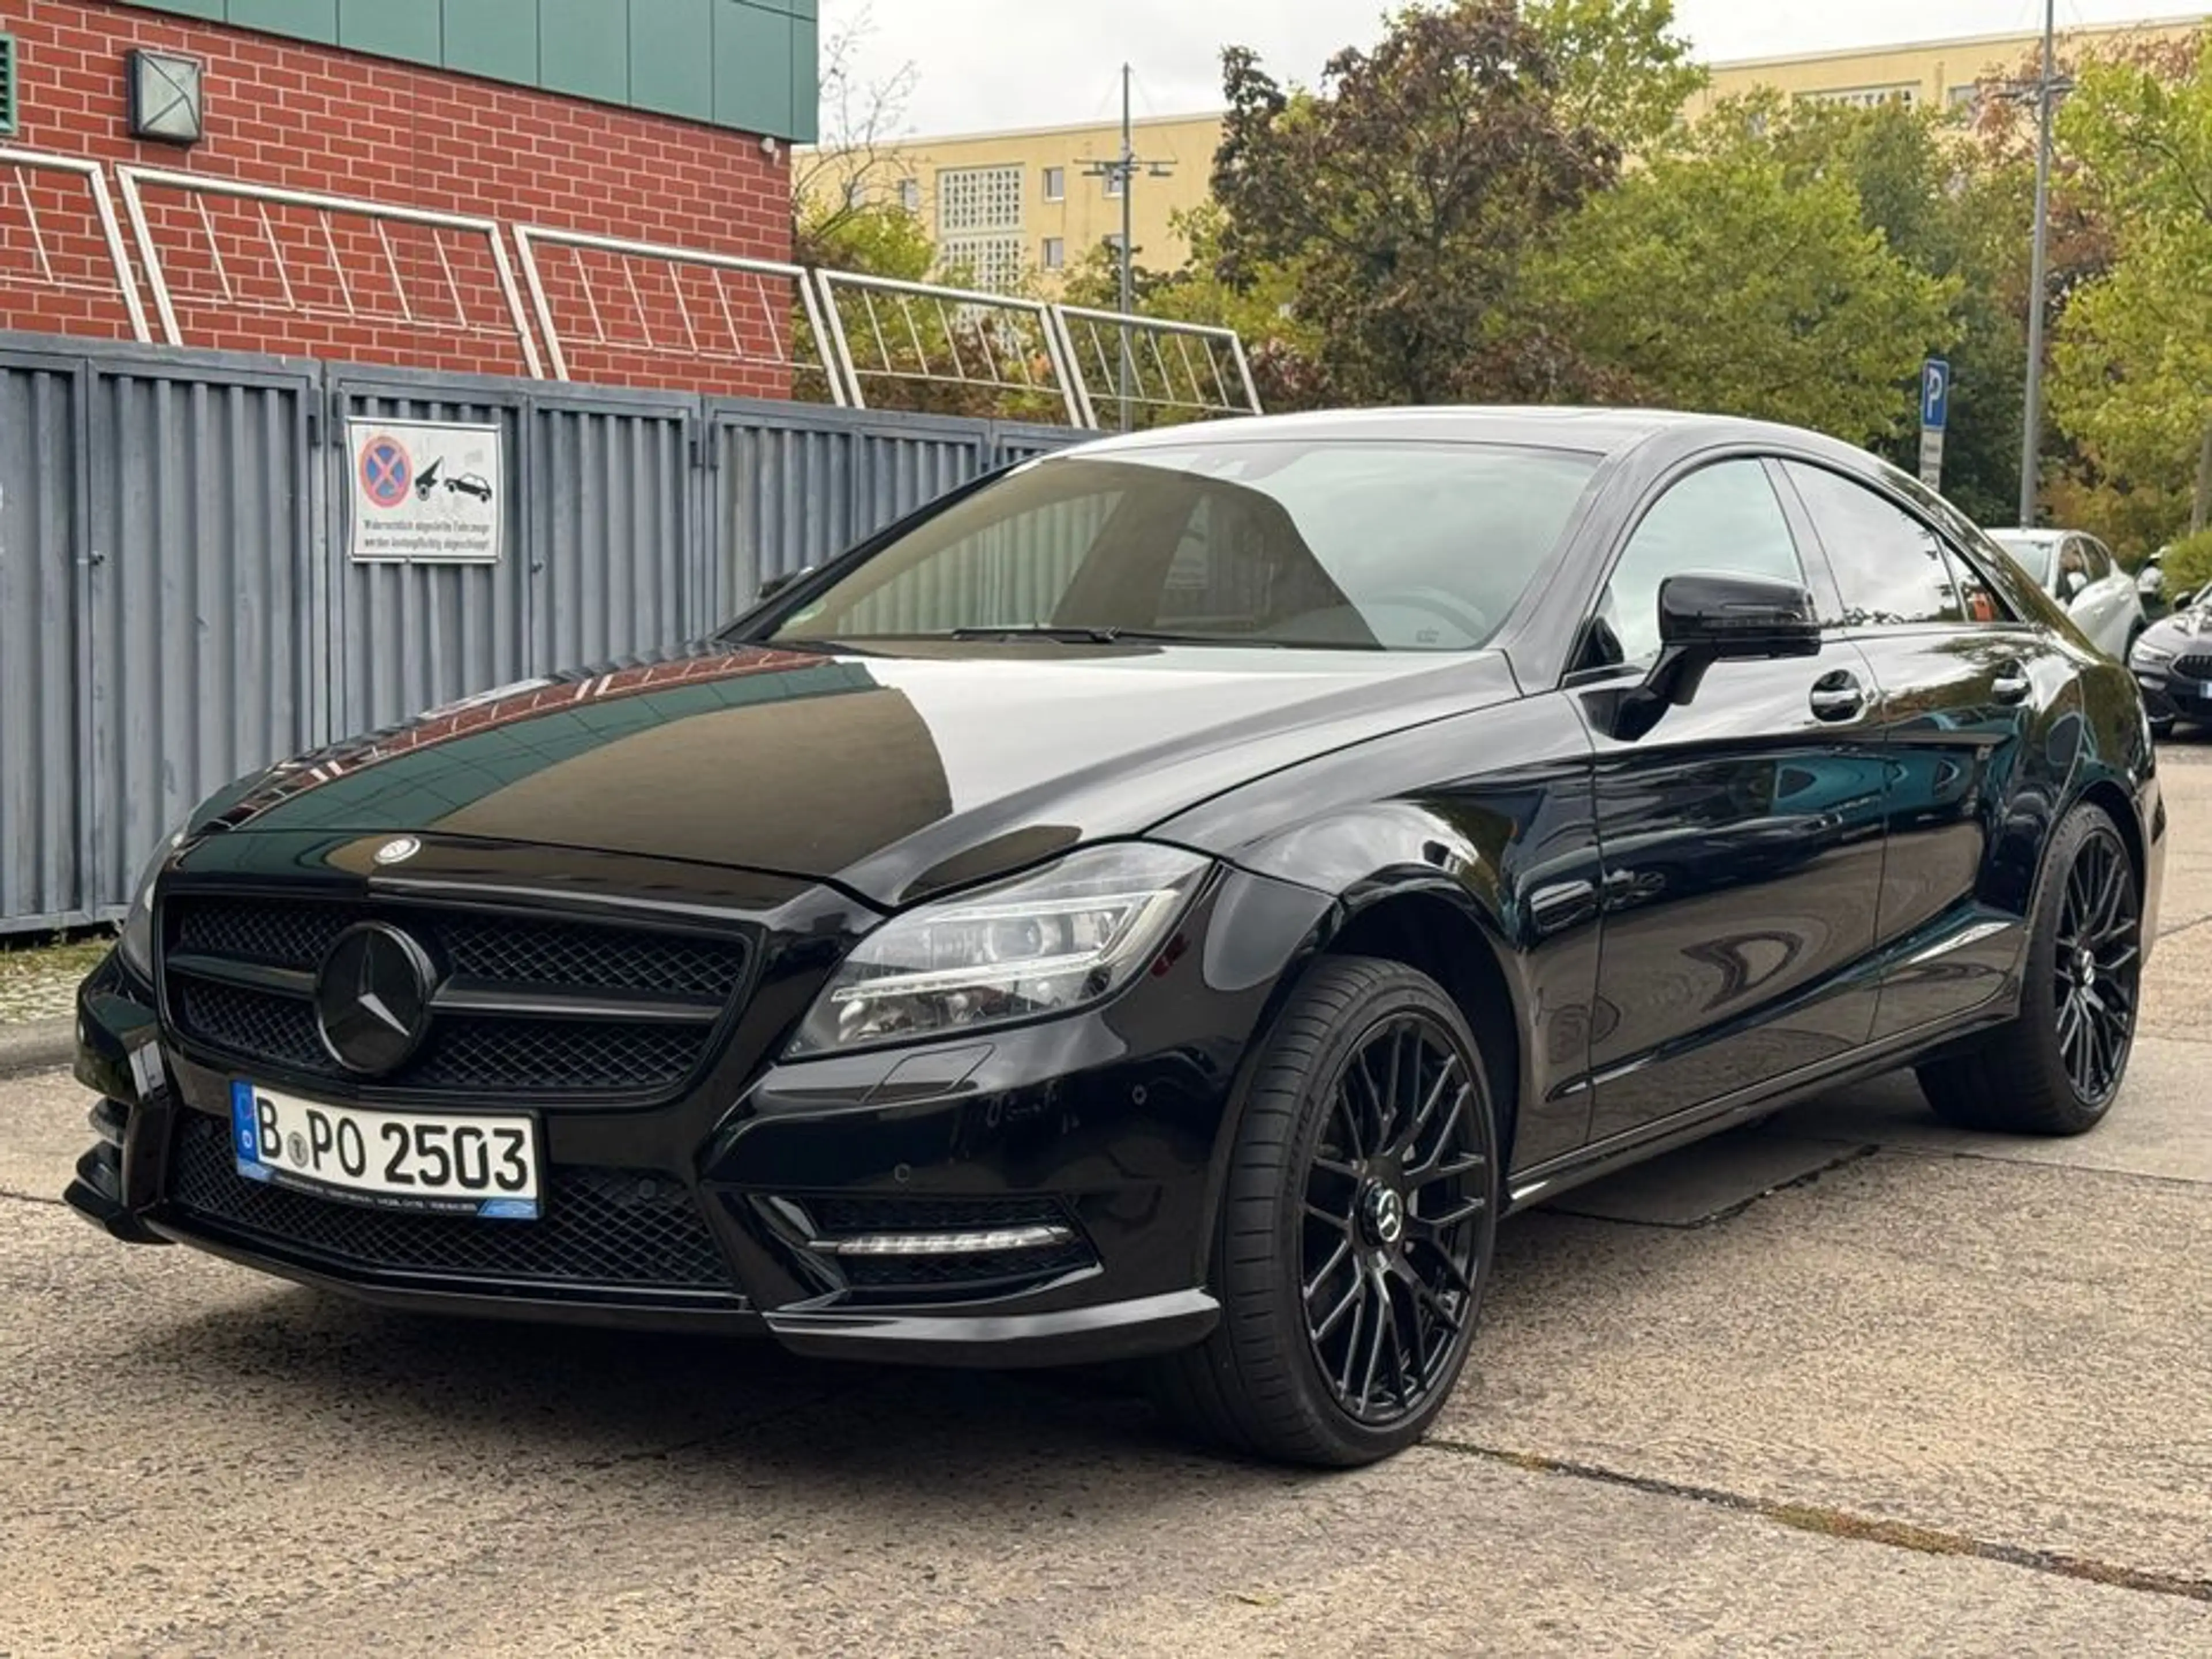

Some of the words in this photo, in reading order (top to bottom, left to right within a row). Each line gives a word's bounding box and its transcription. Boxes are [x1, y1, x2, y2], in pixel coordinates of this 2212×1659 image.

[1927, 367, 1942, 419] P
[257, 1097, 282, 1158] B
[306, 1109, 366, 1177] PO
[381, 1122, 528, 1191] 2503
